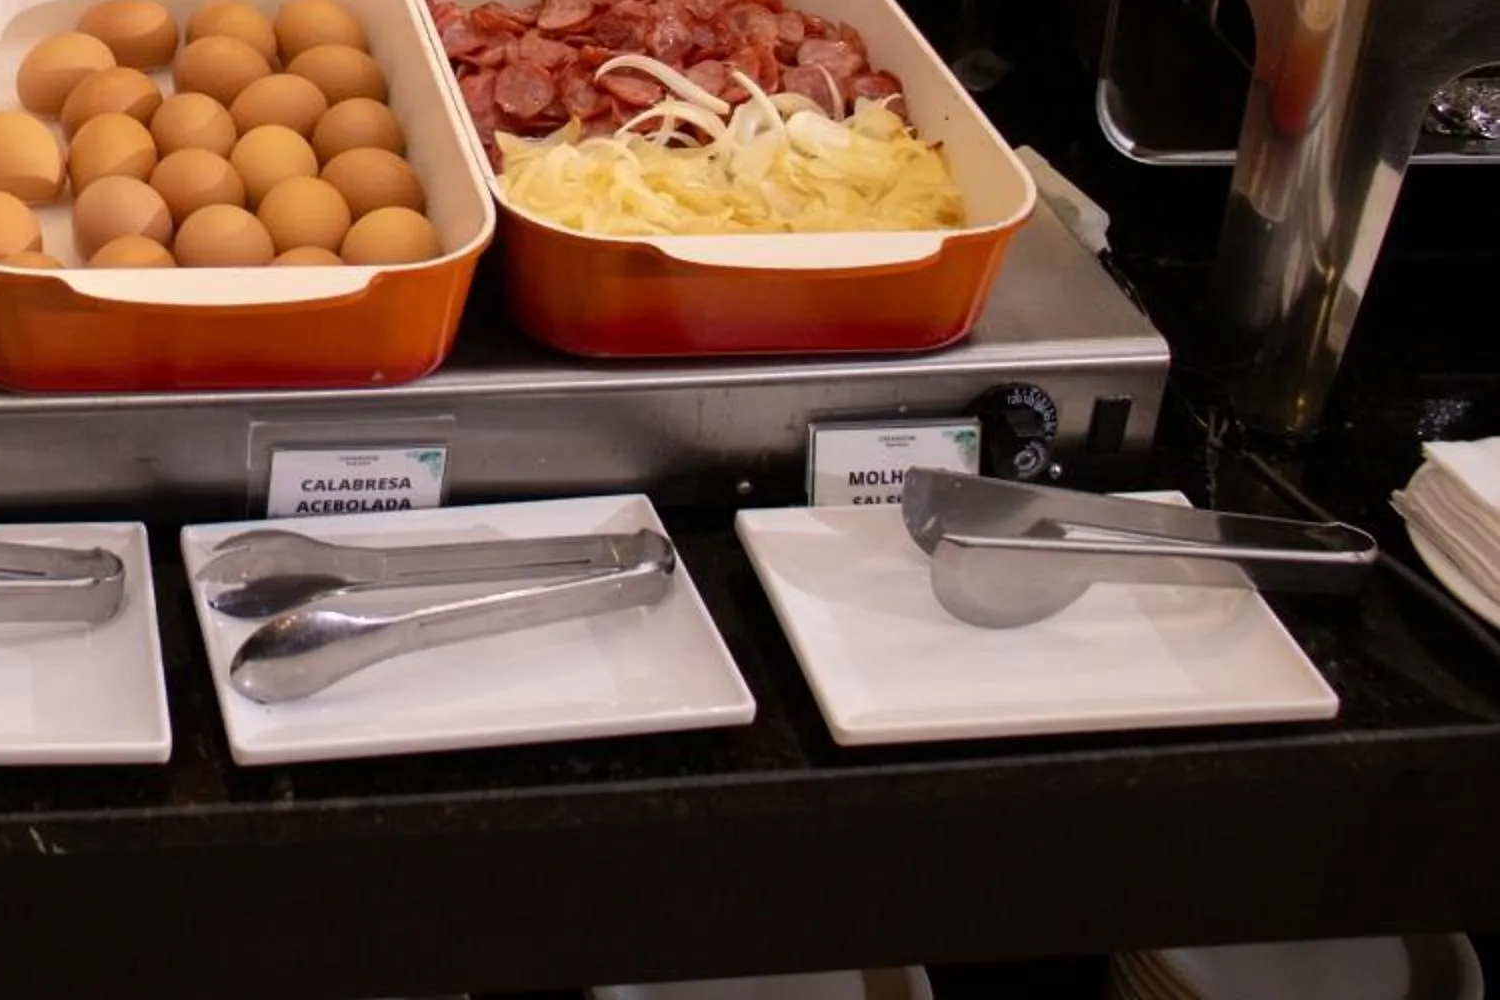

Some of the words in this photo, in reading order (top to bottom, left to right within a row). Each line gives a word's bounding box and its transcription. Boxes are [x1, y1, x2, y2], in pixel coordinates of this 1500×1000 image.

[301, 477, 411, 492] CALABRESA
[849, 470, 903, 485] MOLH
[296, 498, 411, 513] ACEBOLADA
